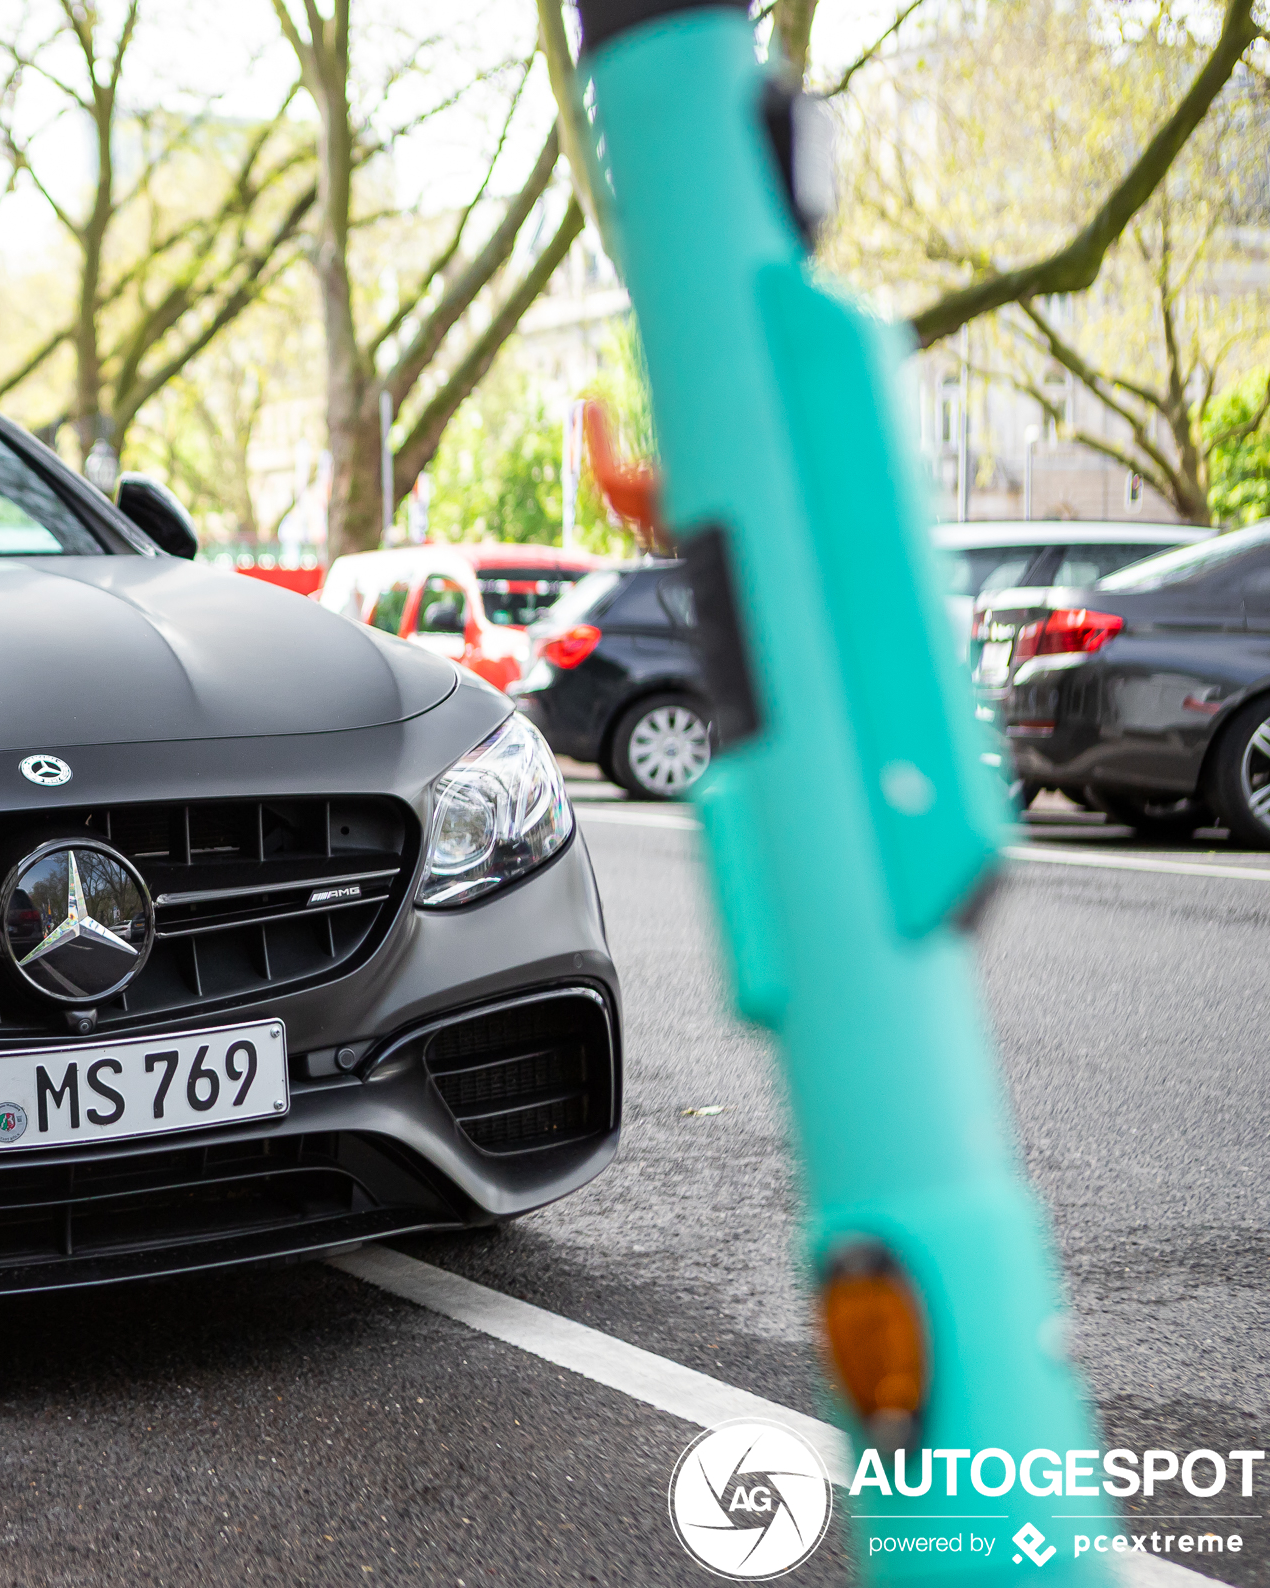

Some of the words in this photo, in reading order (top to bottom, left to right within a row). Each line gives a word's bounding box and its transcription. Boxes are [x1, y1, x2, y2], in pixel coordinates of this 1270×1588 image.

[329, 886, 360, 897] AMG
[35, 1058, 124, 1132] MS
[144, 1039, 258, 1119] 769
